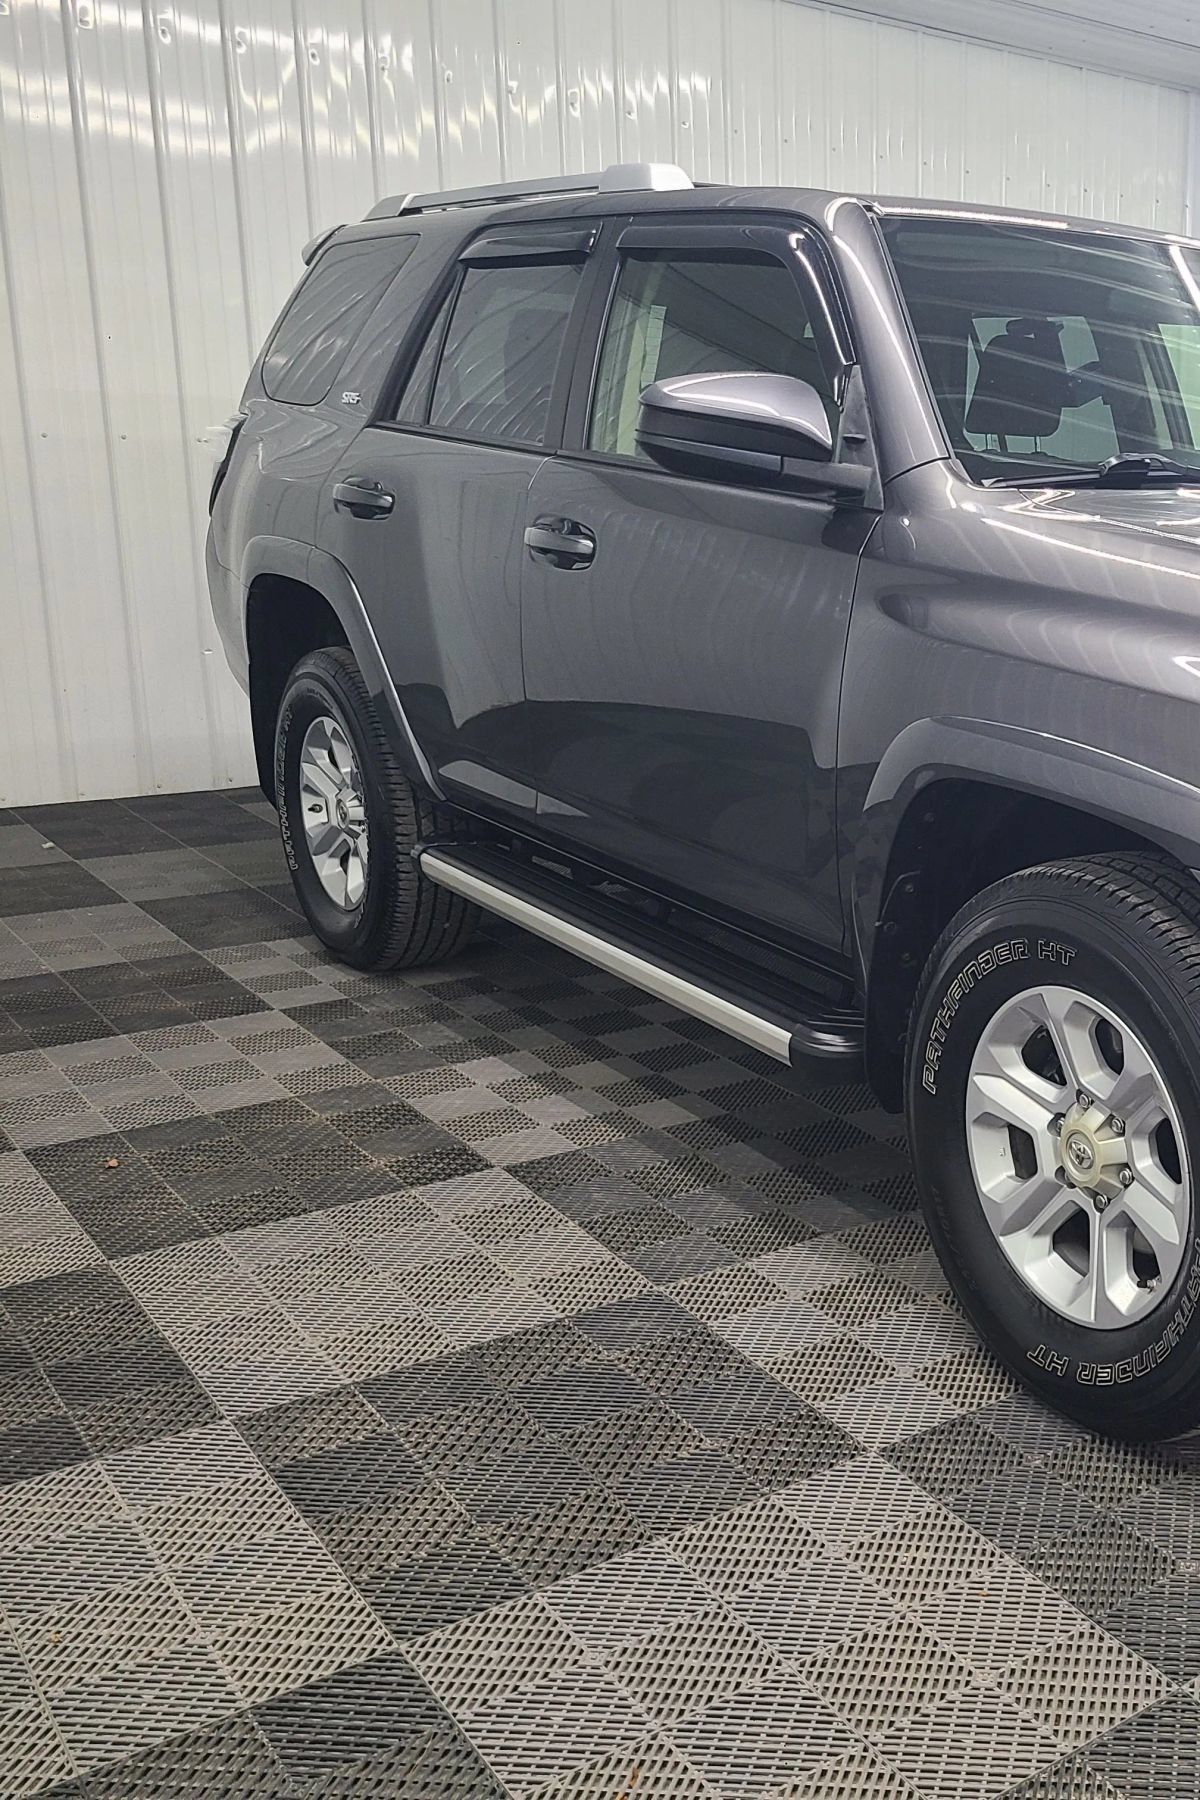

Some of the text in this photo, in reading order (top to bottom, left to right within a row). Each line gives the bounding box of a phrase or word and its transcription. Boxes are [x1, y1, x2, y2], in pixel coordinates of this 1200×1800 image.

[922, 938, 1077, 1095] PATHFINDER HT
[1027, 1344, 1069, 1377] HT
